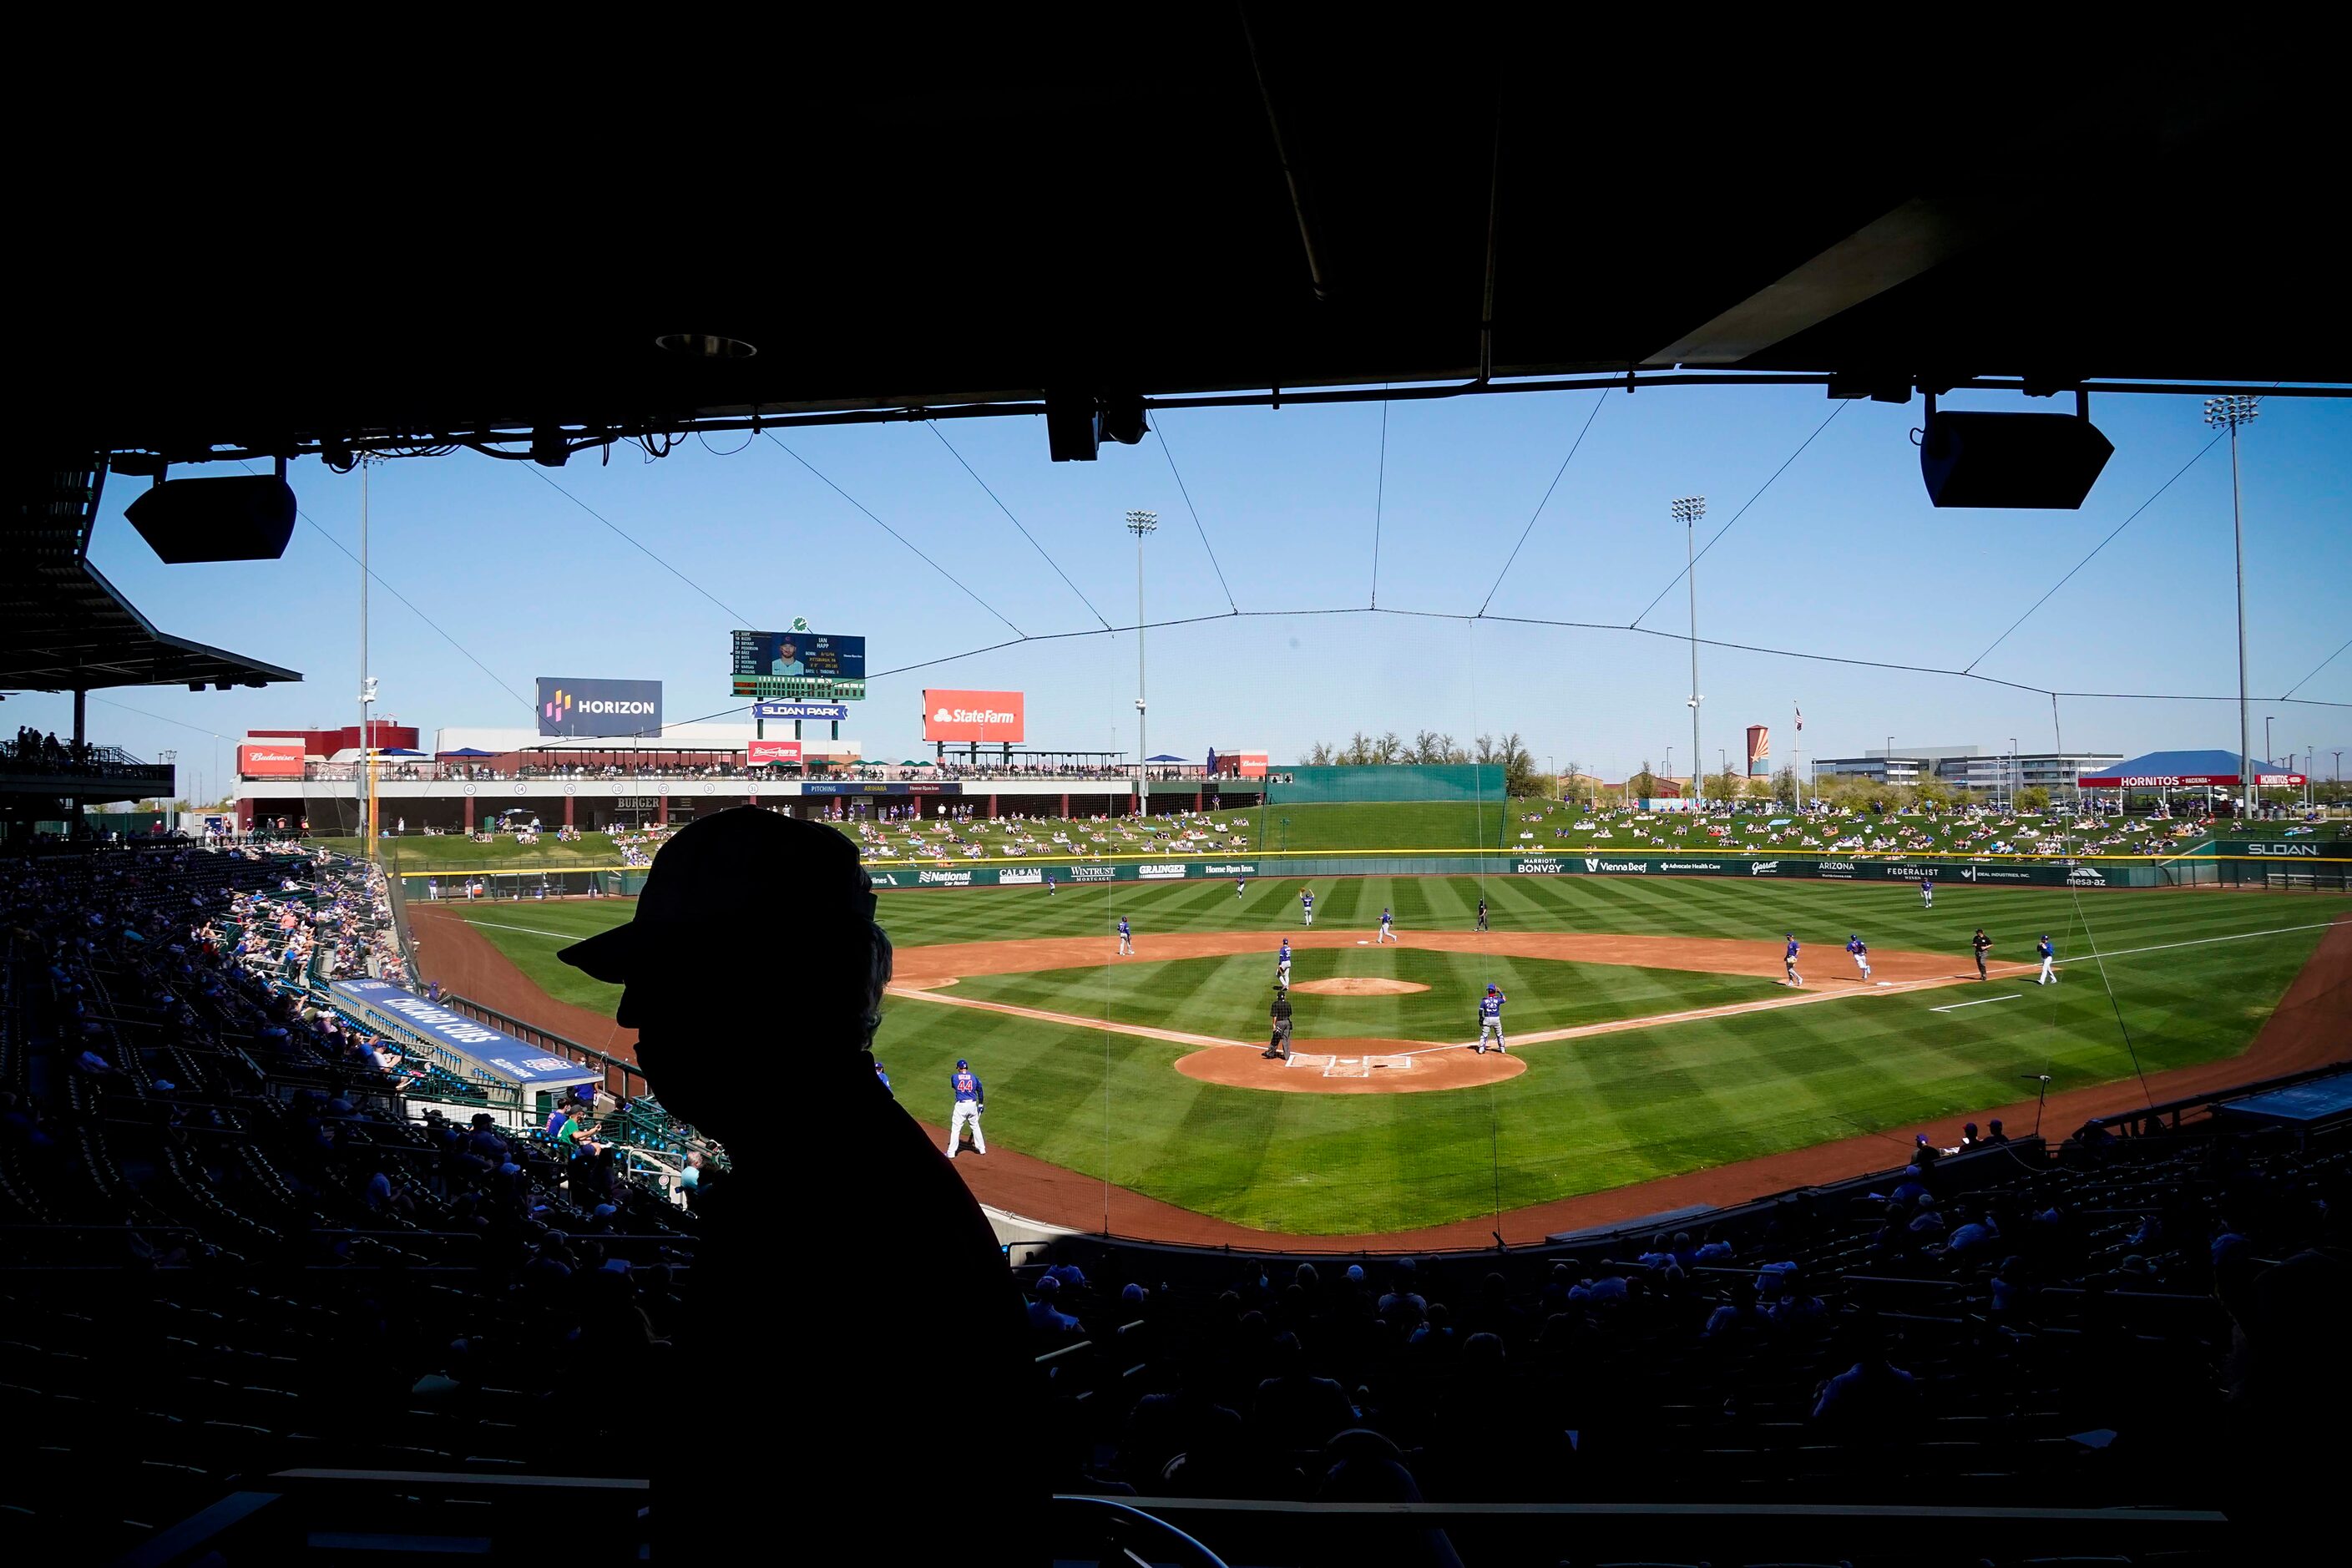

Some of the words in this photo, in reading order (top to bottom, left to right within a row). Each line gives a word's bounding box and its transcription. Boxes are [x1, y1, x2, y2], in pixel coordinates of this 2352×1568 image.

[579, 701, 655, 715] HORIZON
[762, 706, 804, 715] SLOAN
[250, 752, 296, 761] Budweiser
[2121, 776, 2179, 787] HORNITOS
[2260, 775, 2288, 784] HORNITOS
[618, 797, 659, 807] BURGER
[2248, 844, 2316, 855] SLOAN
[1139, 865, 1185, 874] GRAINGER
[1226, 865, 1241, 873] Run
[1518, 864, 1561, 873] BONVOY
[1600, 862, 1628, 871] Vienna
[1628, 862, 1647, 873] Beef
[1752, 861, 1779, 875] Garrett
[382, 999, 459, 1024] CHICAGO
[435, 1024, 501, 1043] CUBS
[957, 1080, 973, 1092] 44
